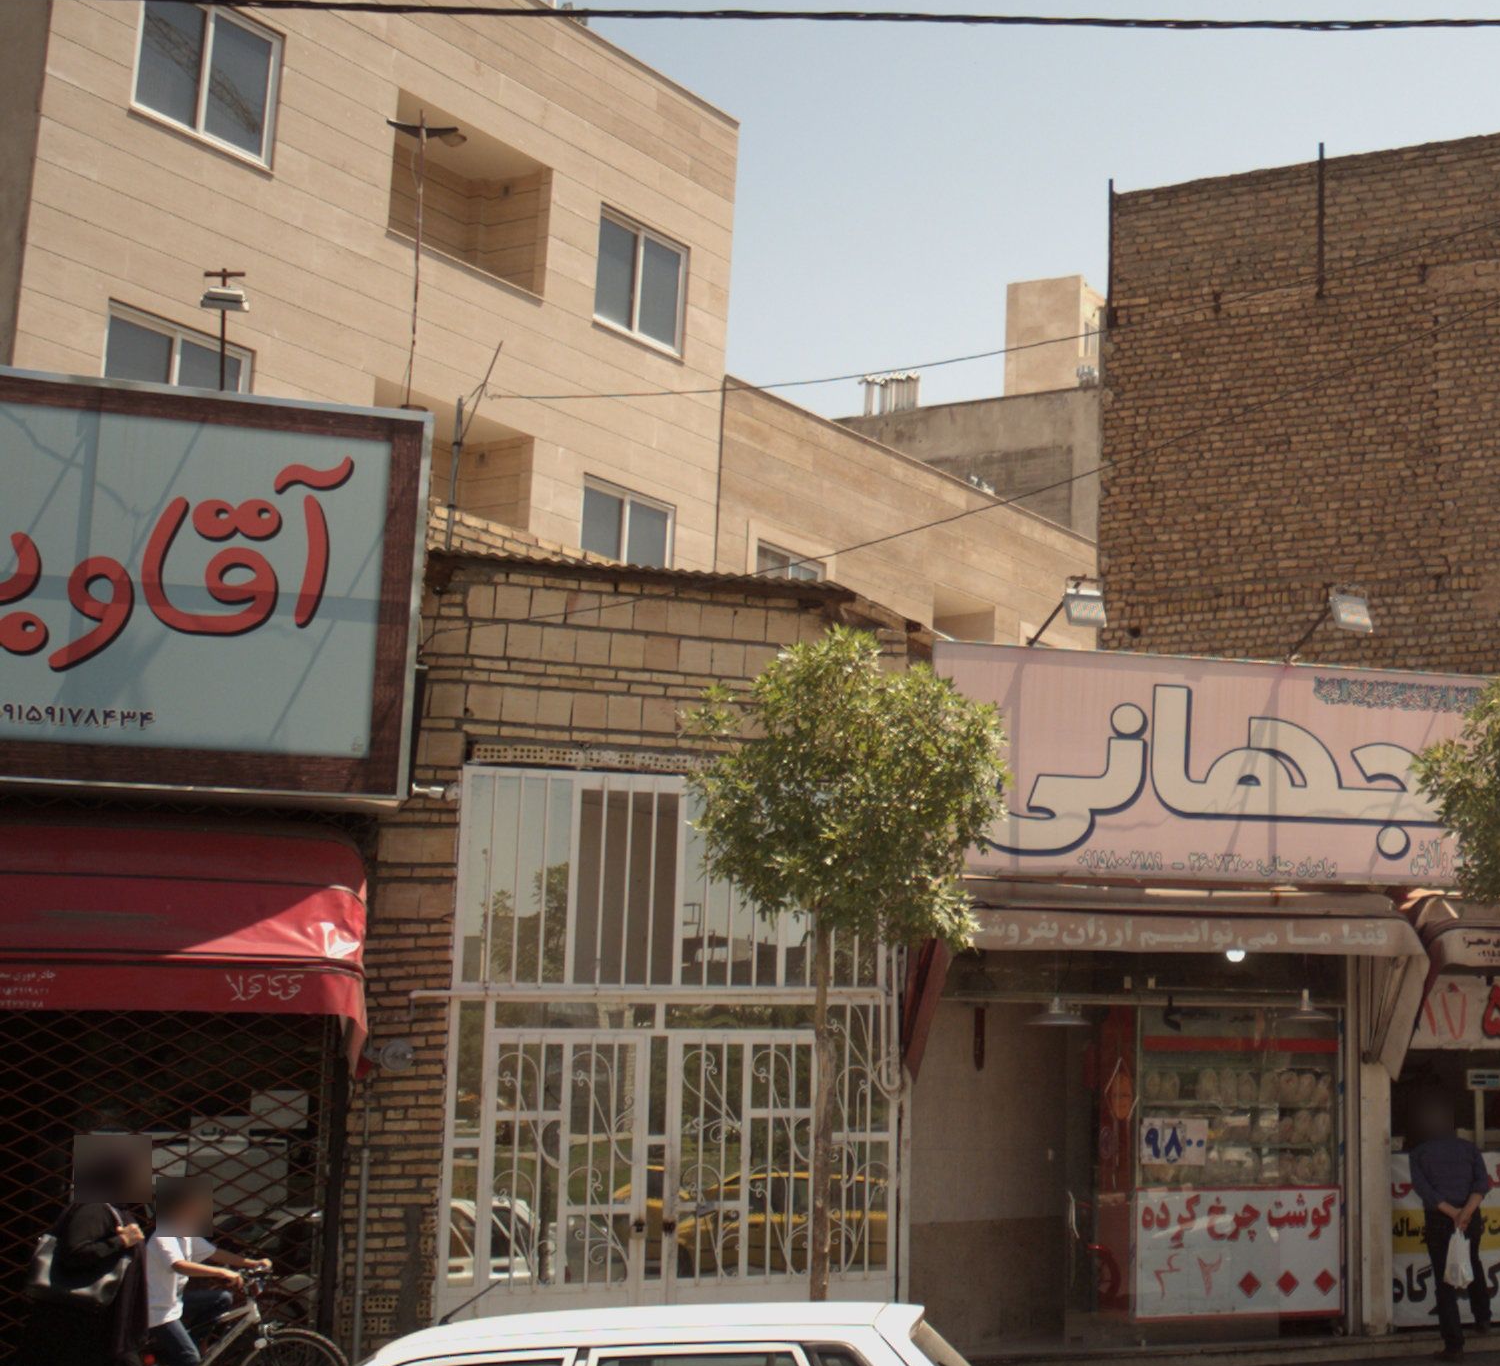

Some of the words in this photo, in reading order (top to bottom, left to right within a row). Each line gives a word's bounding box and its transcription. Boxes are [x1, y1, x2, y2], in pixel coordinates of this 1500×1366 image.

[1, 703, 155, 729] ۹۱۵۹۱۷۸۴۳۴
[1206, 1195, 1261, 1242] چرخ
[1266, 1193, 1337, 1240] گوشت
